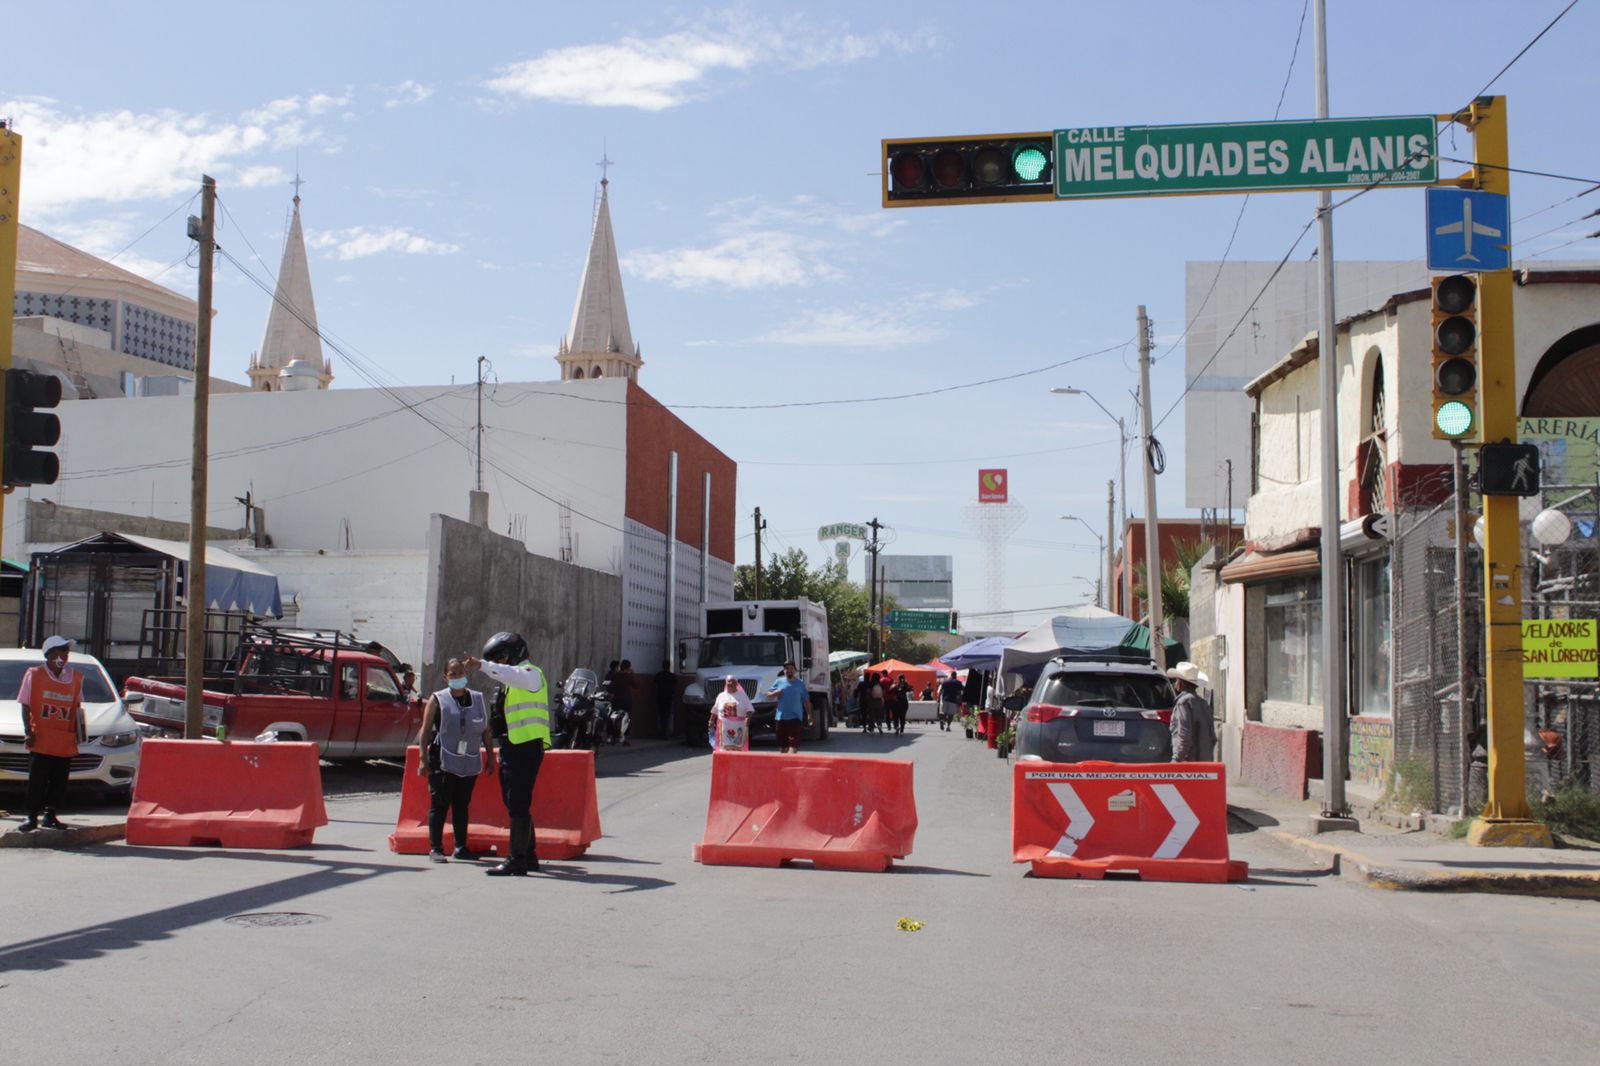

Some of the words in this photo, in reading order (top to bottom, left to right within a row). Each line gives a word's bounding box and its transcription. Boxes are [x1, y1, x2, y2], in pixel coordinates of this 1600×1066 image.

[1067, 127, 1126, 144] CALLE
[1065, 139, 1290, 183] MELQUIADES
[1300, 133, 1430, 174] ALANIS
[1517, 418, 1598, 444] ARERÍA
[821, 524, 865, 538] RANGER
[1521, 622, 1590, 638] VELADORAS
[1549, 640, 1562, 648] de
[1522, 649, 1548, 663] SAN
[1551, 648, 1598, 663] LORENZO
